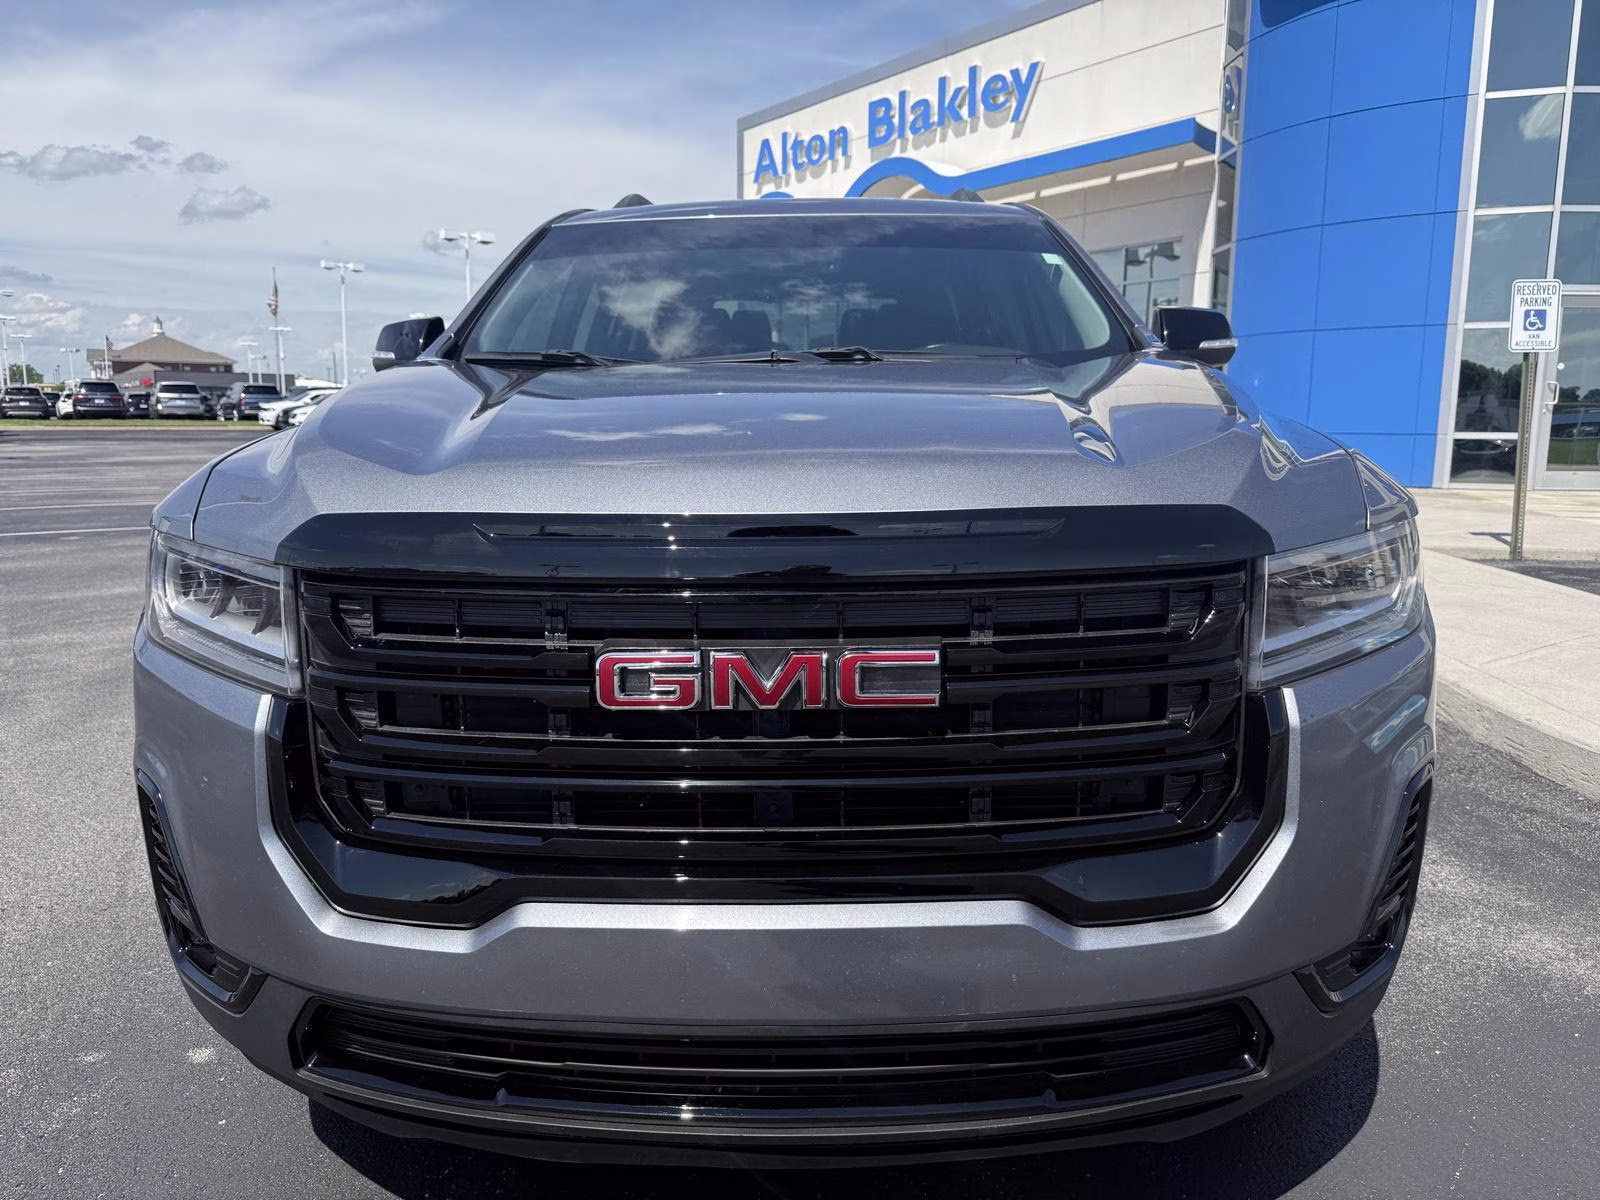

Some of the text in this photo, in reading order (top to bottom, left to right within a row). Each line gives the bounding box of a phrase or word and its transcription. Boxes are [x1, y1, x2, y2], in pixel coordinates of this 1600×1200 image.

[753, 60, 1042, 184] Alton Blakley
[1516, 284, 1557, 296] RESERVED
[1519, 297, 1552, 307] PARKING
[595, 649, 940, 710] GMC
